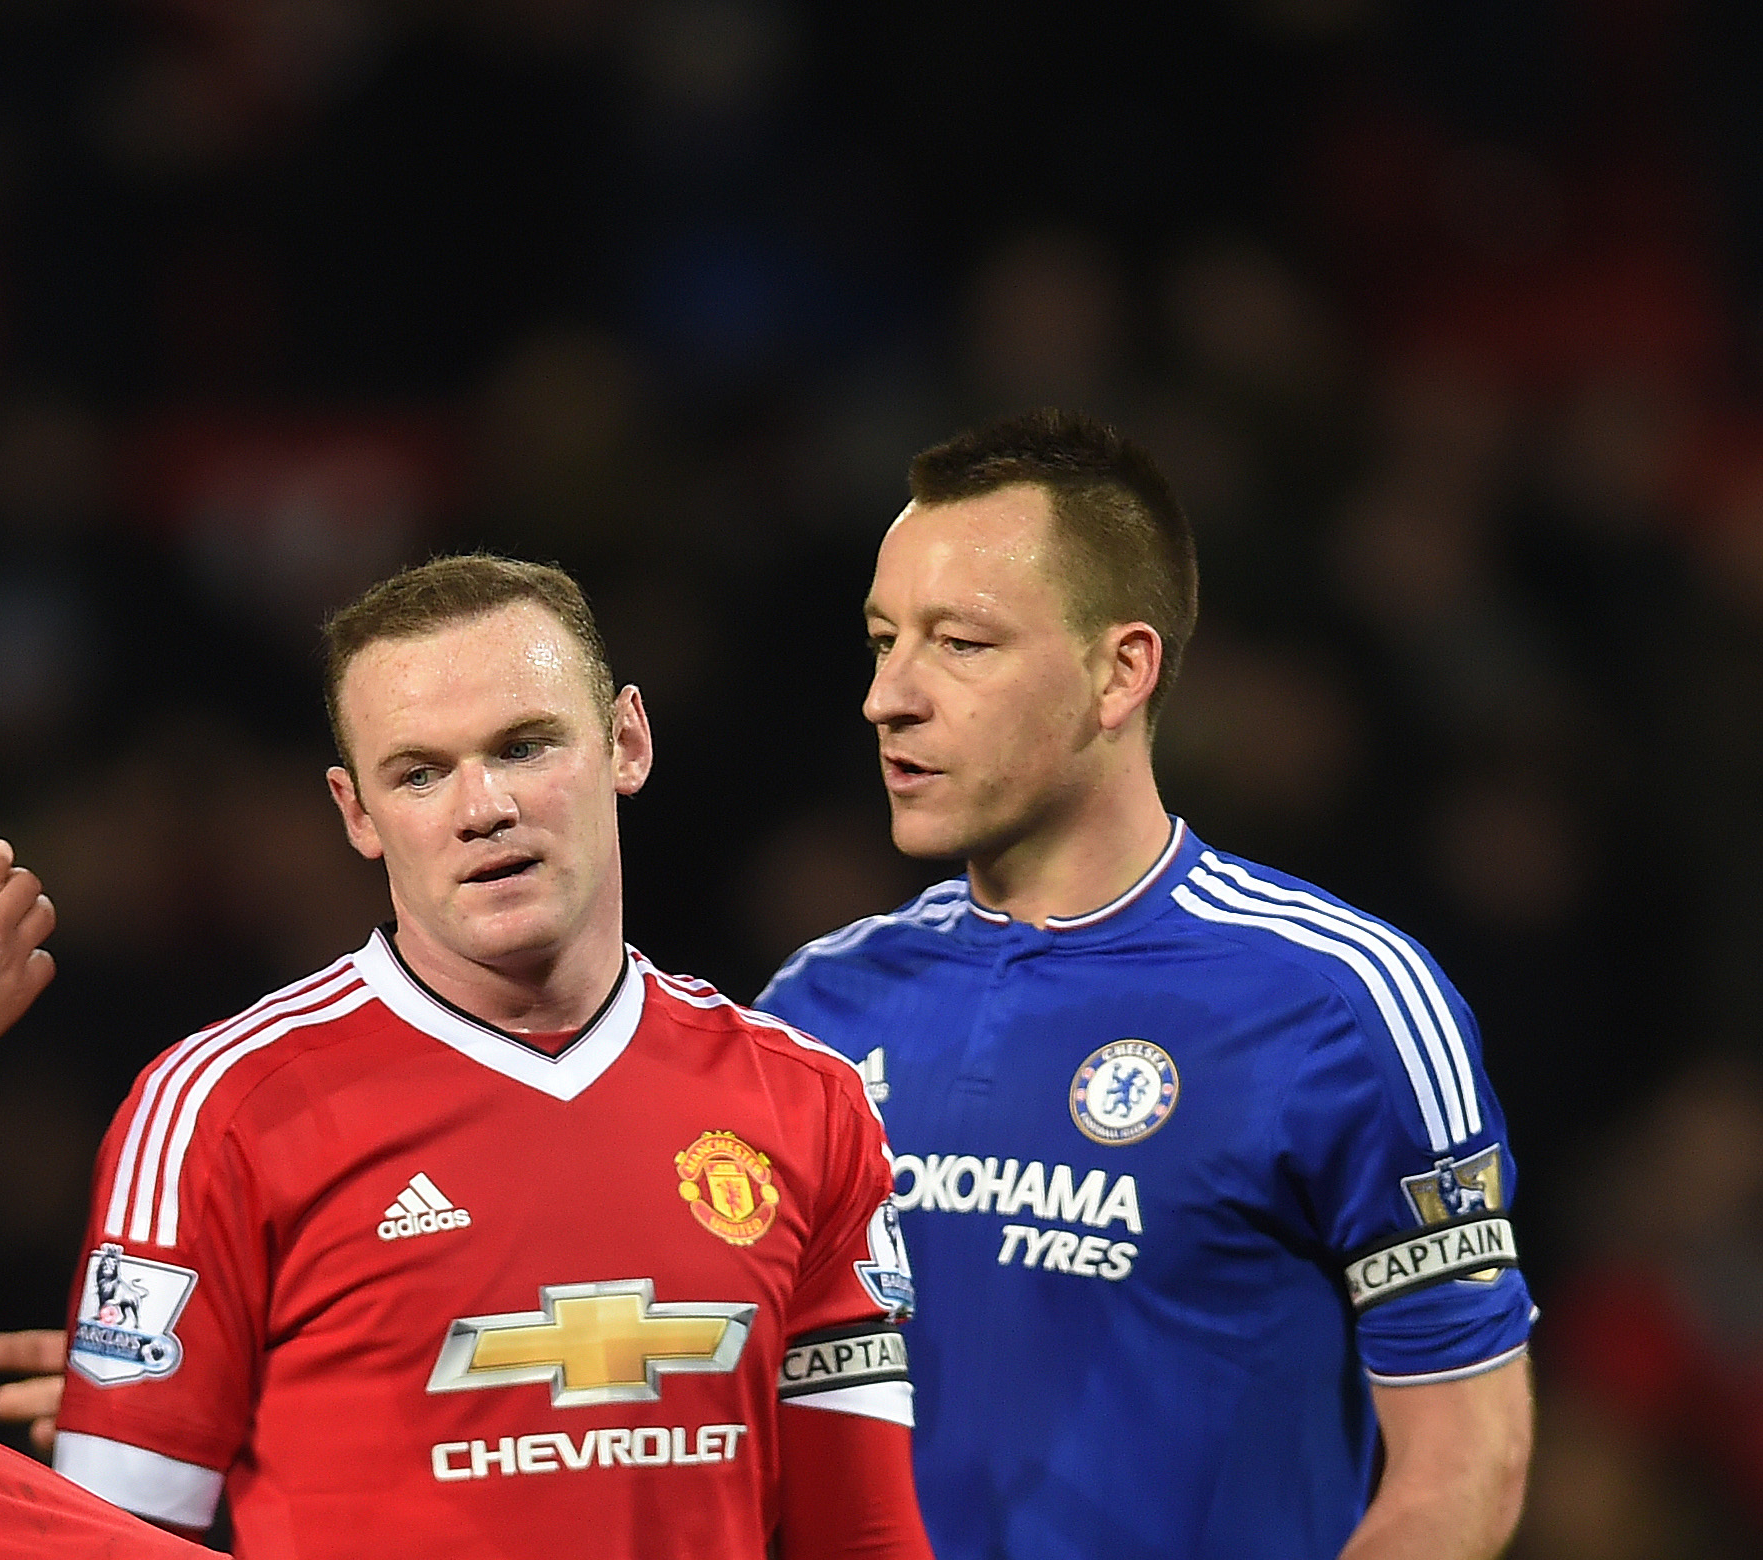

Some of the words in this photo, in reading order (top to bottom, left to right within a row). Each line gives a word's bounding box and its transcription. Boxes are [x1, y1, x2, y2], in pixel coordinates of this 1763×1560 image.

[892, 1154, 1143, 1234] OKOHAMA
[377, 1208, 473, 1241] adidas
[997, 1225, 1138, 1281] TYRES
[1362, 1222, 1505, 1289] CAPTAIN
[782, 1338, 907, 1381] CAPTA
[431, 1424, 748, 1482] CHEVROLET
